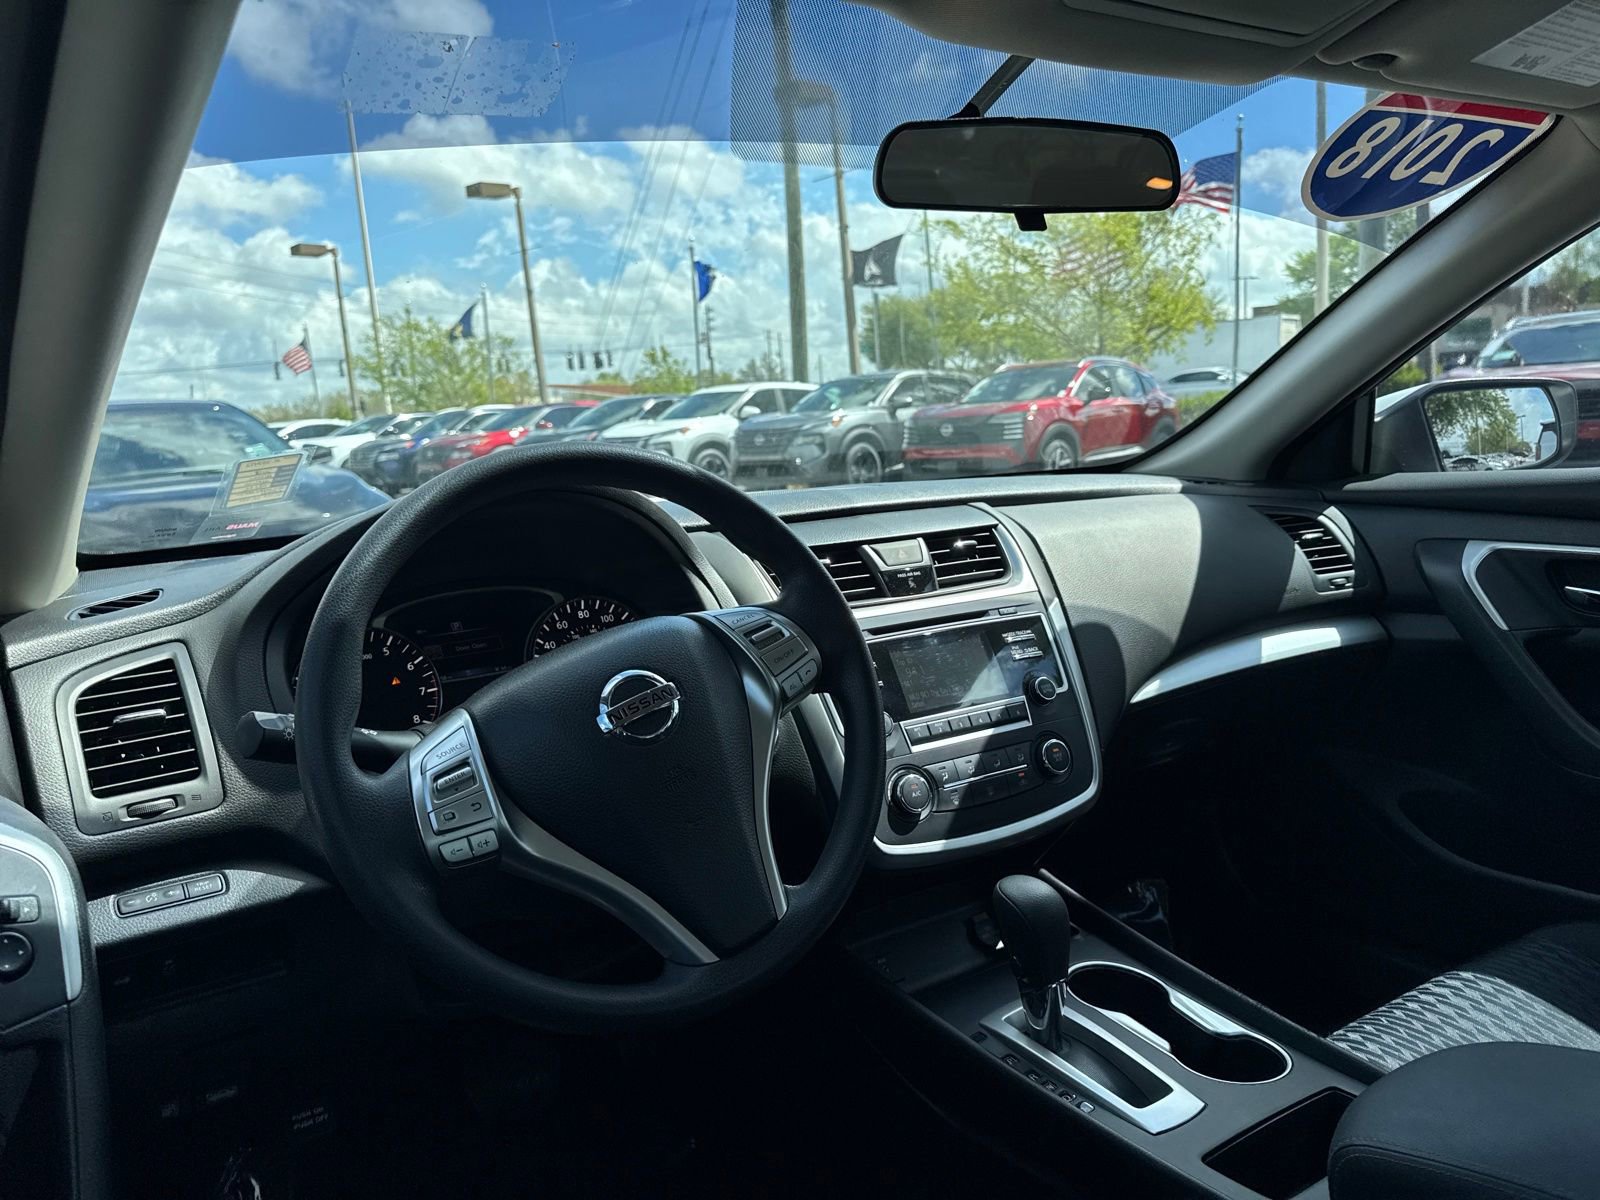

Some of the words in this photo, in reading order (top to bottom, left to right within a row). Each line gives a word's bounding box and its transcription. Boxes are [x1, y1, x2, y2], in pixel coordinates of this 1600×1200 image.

[577, 609, 590, 619] 80
[600, 614, 614, 623] 100
[731, 613, 754, 625] CANCEL
[556, 620, 569, 630] 60
[544, 640, 556, 650] 40
[382, 646, 390, 656] 5
[406, 659, 415, 671] 6
[418, 686, 426, 696] 7
[609, 687, 675, 724] NISSAN
[412, 714, 421, 724] 8
[436, 742, 466, 760] SOURCE
[444, 771, 466, 785] ENTER
